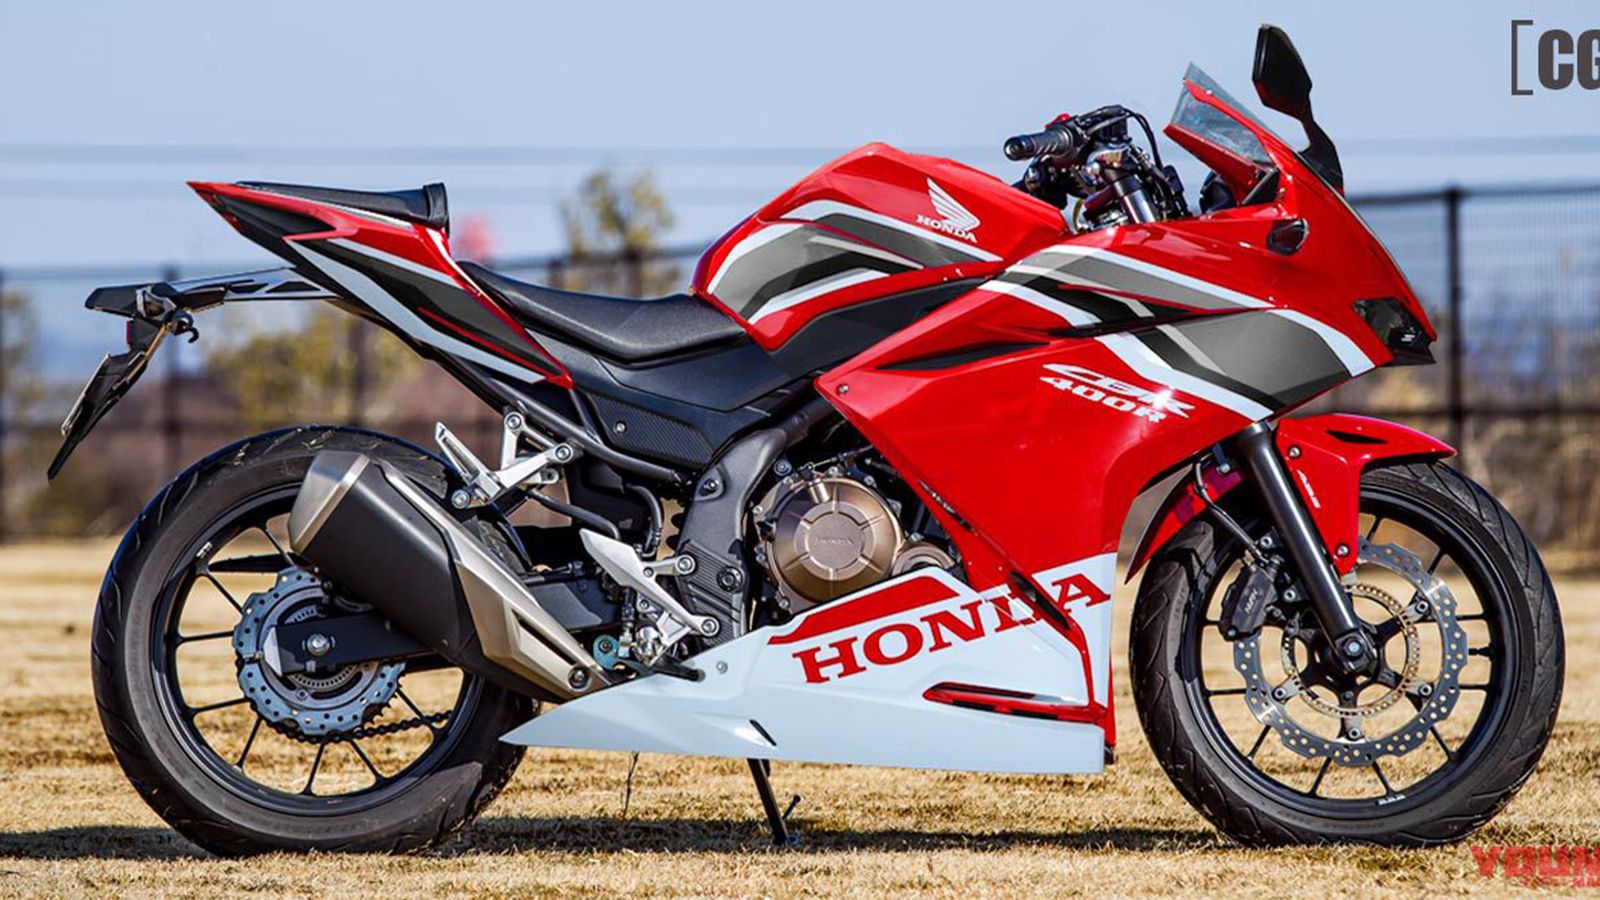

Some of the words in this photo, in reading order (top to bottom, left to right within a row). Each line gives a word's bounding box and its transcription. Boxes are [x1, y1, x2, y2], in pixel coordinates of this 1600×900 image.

[916, 214, 978, 244] HONDA
[1040, 377, 1167, 423] 400R
[1043, 363, 1196, 419] CBR
